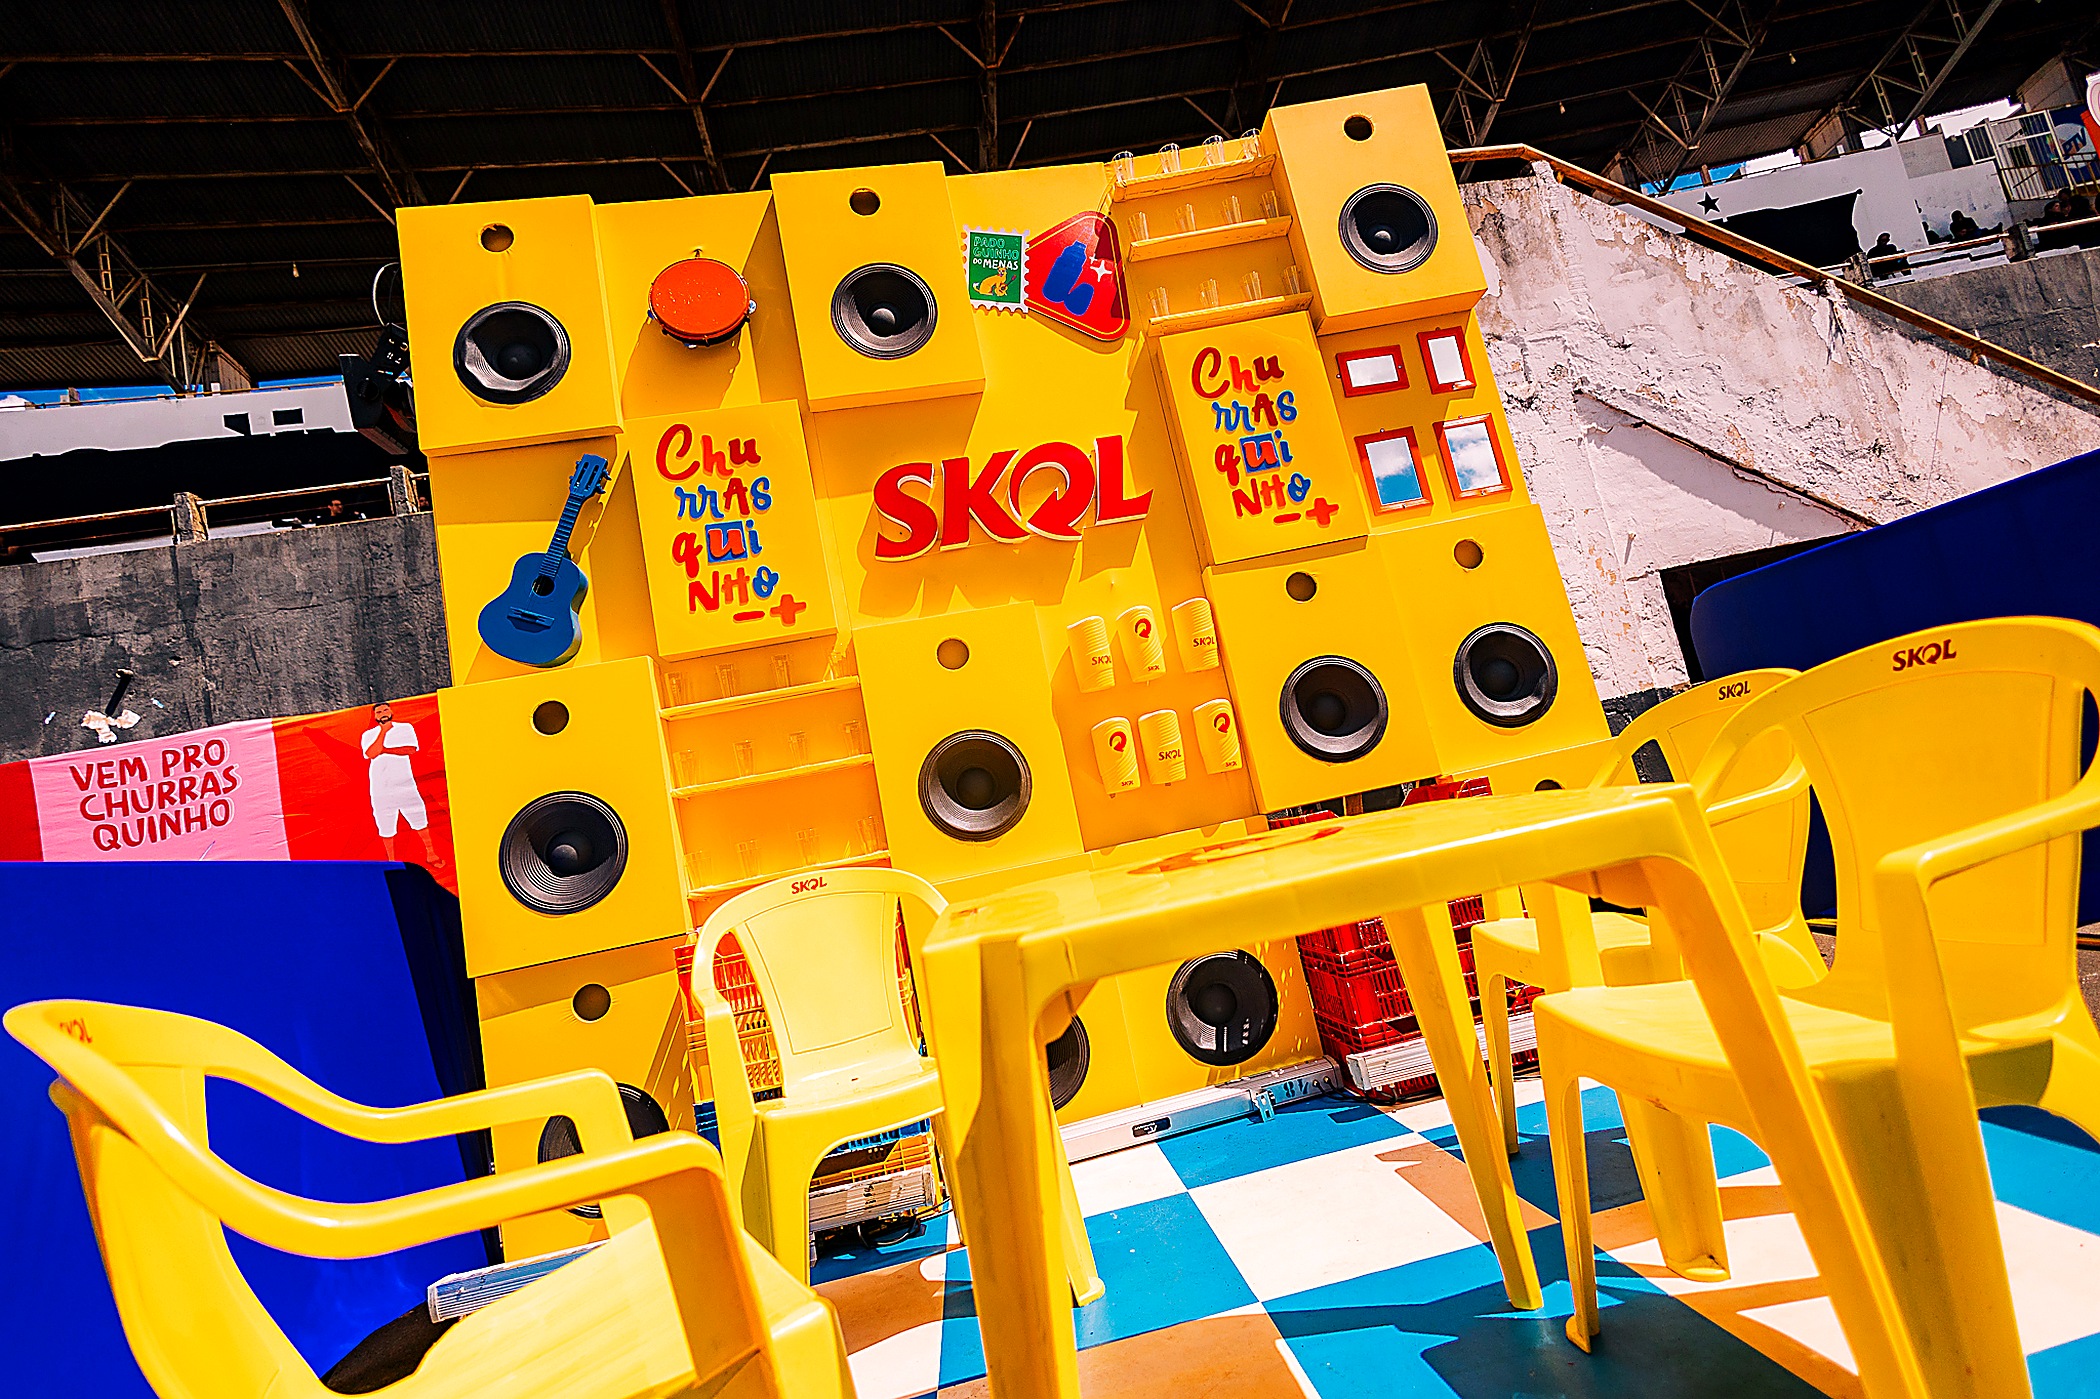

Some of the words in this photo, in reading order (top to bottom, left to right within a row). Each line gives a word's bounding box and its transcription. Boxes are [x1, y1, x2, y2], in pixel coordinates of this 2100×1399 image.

[983, 258, 1018, 270] MENAS
[1191, 346, 1285, 399] Chu
[656, 423, 762, 481] Chu
[873, 434, 1154, 563] SKOL
[1193, 636, 1215, 648] SKOL
[1892, 639, 1957, 672] SKOL
[1718, 680, 1751, 701] SKOL
[69, 756, 148, 792] VEM
[161, 738, 230, 778] PRO
[1158, 748, 1182, 761] SKOL
[79, 765, 242, 822] CHURRAS
[92, 798, 233, 852] QUINHO
[791, 876, 828, 895] SKOL
